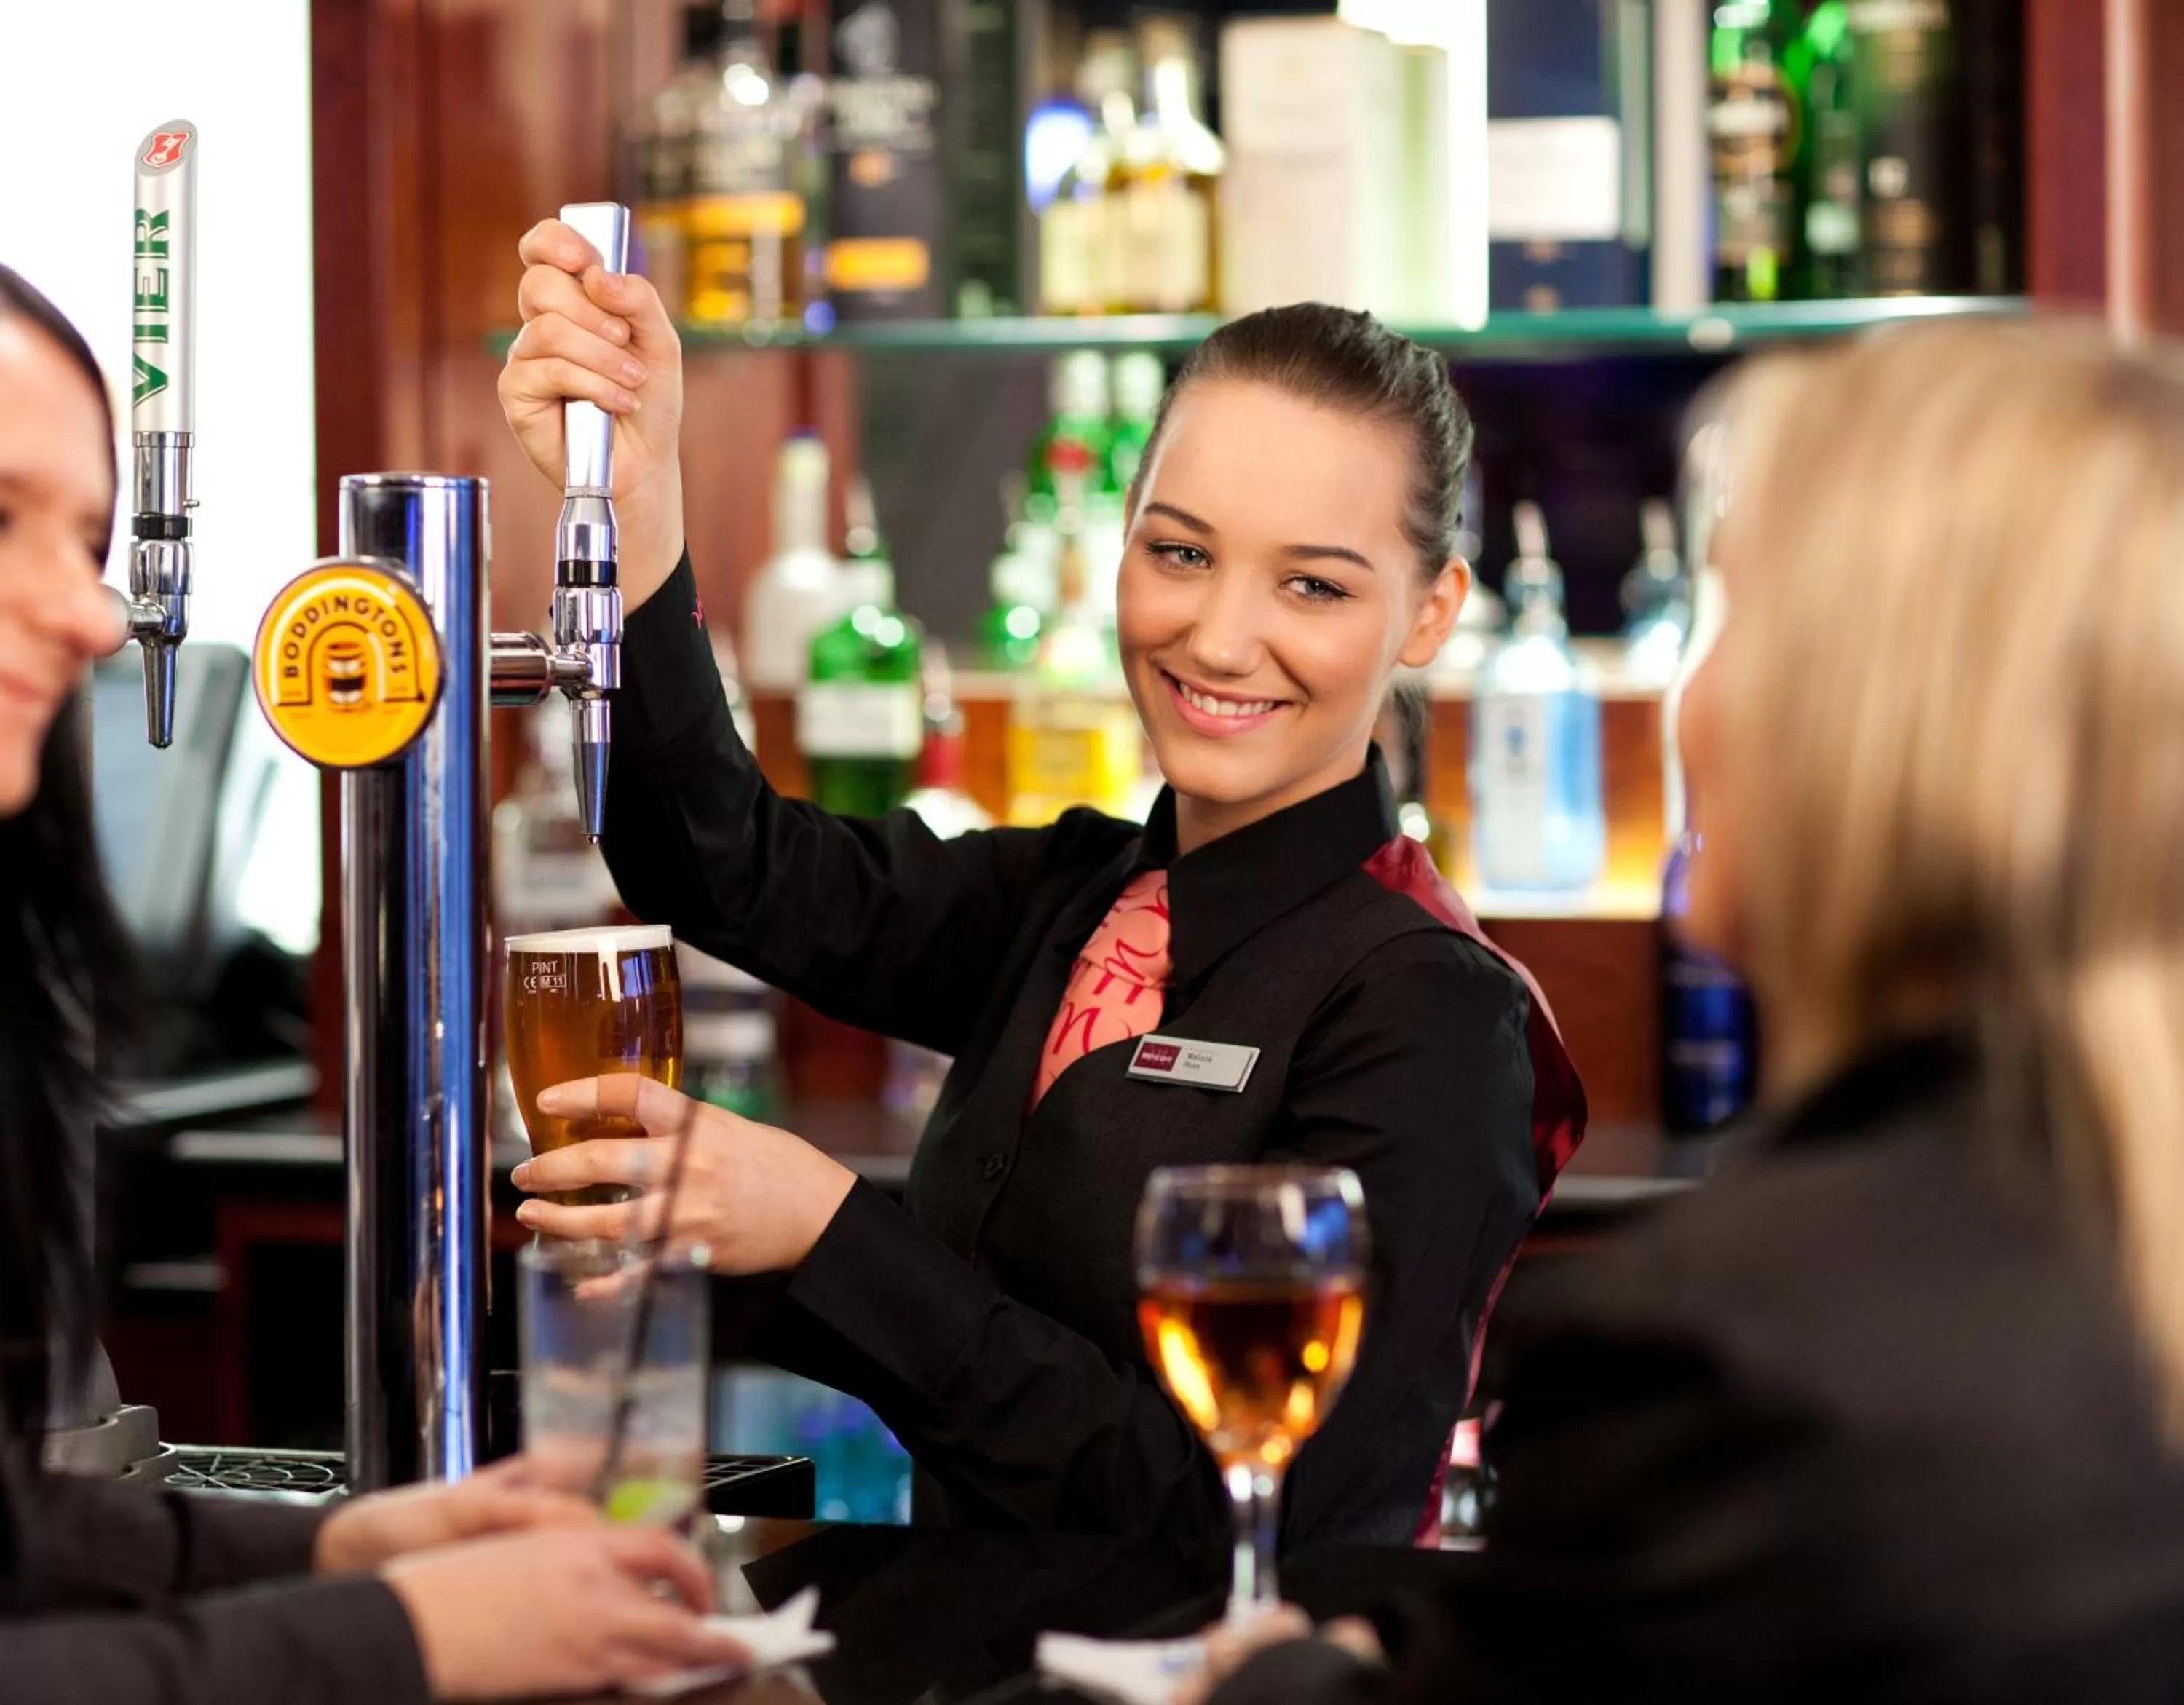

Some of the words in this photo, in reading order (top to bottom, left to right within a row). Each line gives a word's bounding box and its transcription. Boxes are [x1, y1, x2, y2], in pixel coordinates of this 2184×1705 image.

[133, 209, 169, 408] VIER
[283, 595, 408, 679] BODDINGTONS
[532, 960, 559, 974] PINT
